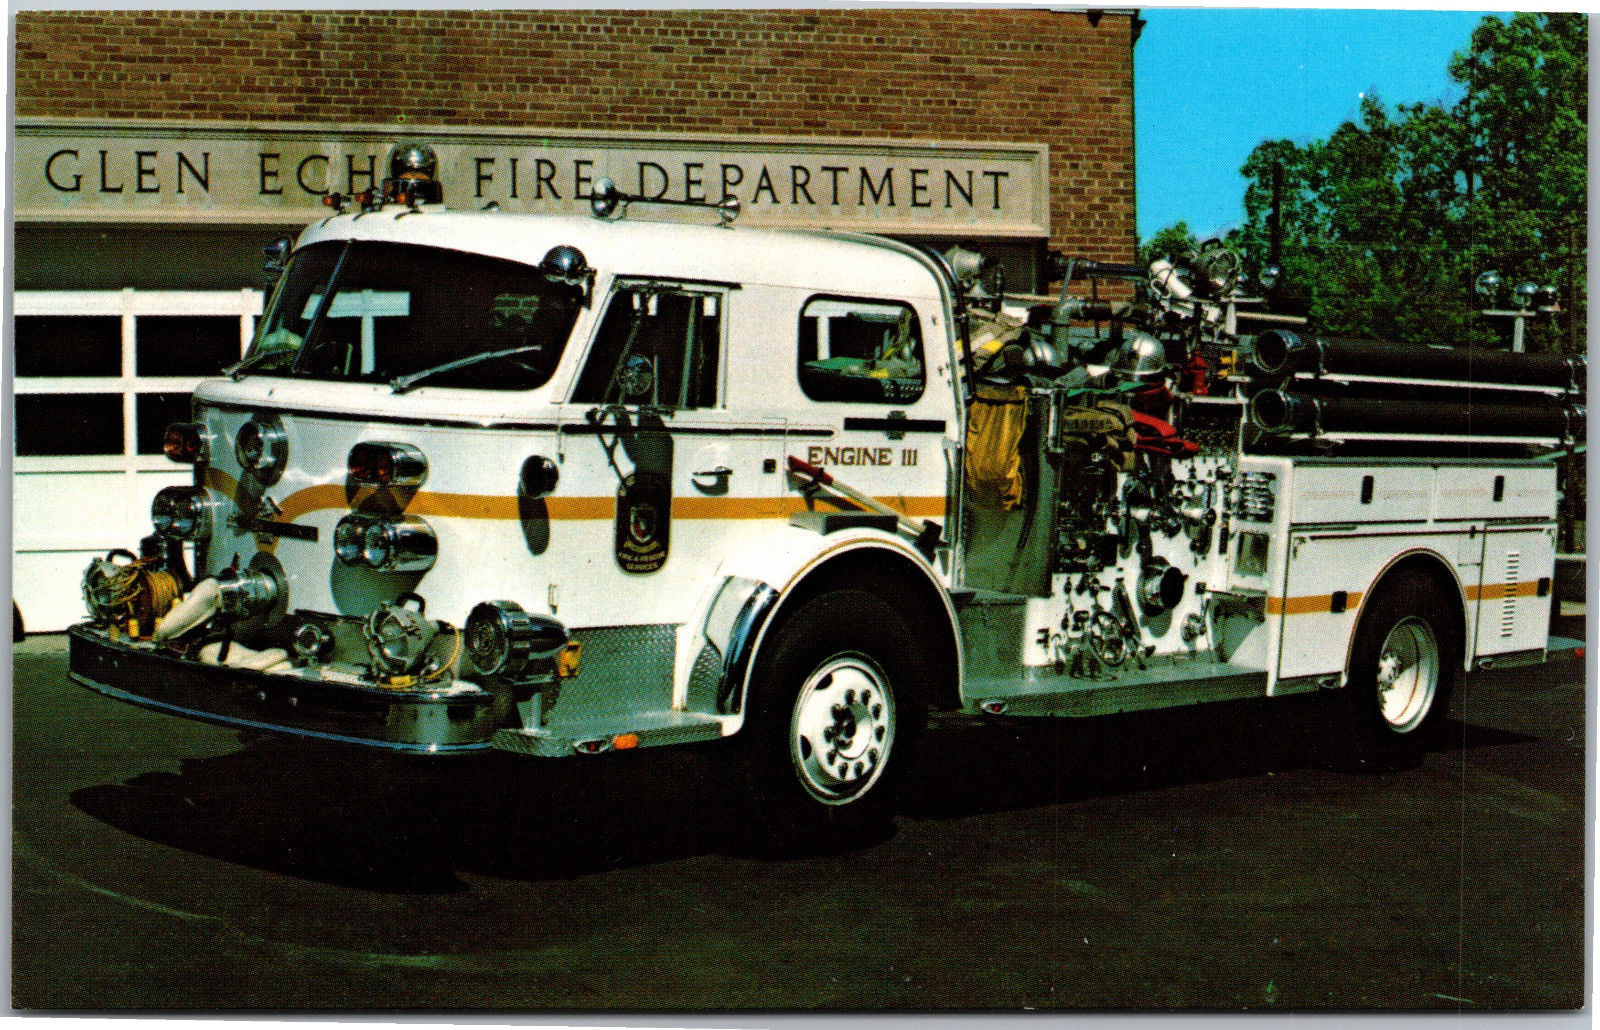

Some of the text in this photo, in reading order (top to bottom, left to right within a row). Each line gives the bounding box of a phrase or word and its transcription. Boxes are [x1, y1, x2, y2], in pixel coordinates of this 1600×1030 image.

[45, 149, 1009, 210] GLEN ECH FIRE DEPARTMENT
[808, 446, 918, 466] ENGINE III
